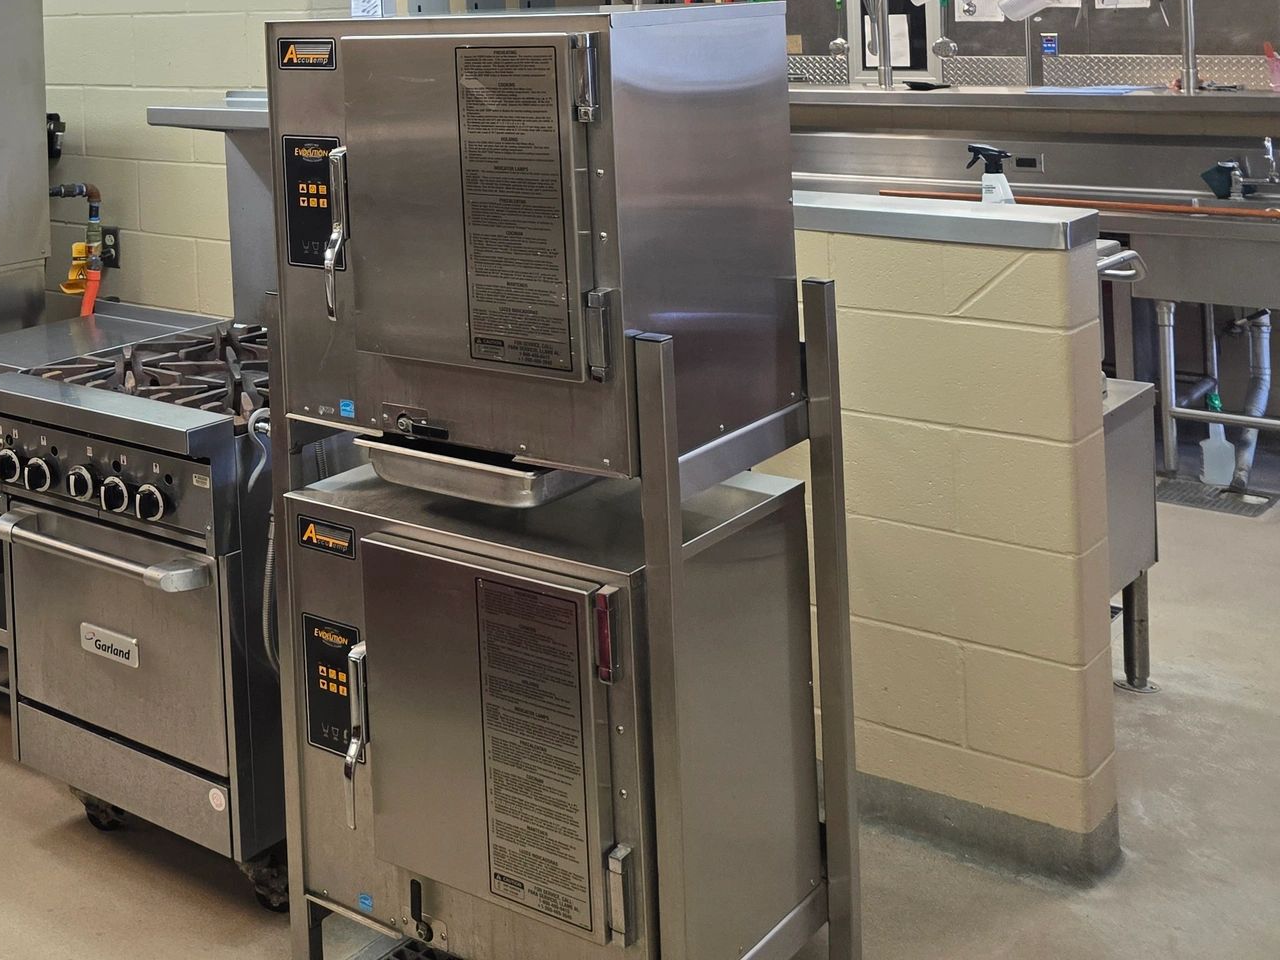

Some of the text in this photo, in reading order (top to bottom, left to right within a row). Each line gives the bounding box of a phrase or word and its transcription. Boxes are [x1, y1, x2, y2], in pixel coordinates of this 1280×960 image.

[294, 147, 329, 158] EVOLUTION
[314, 627, 349, 646] EVOLUTION
[94, 639, 131, 660] Garland
